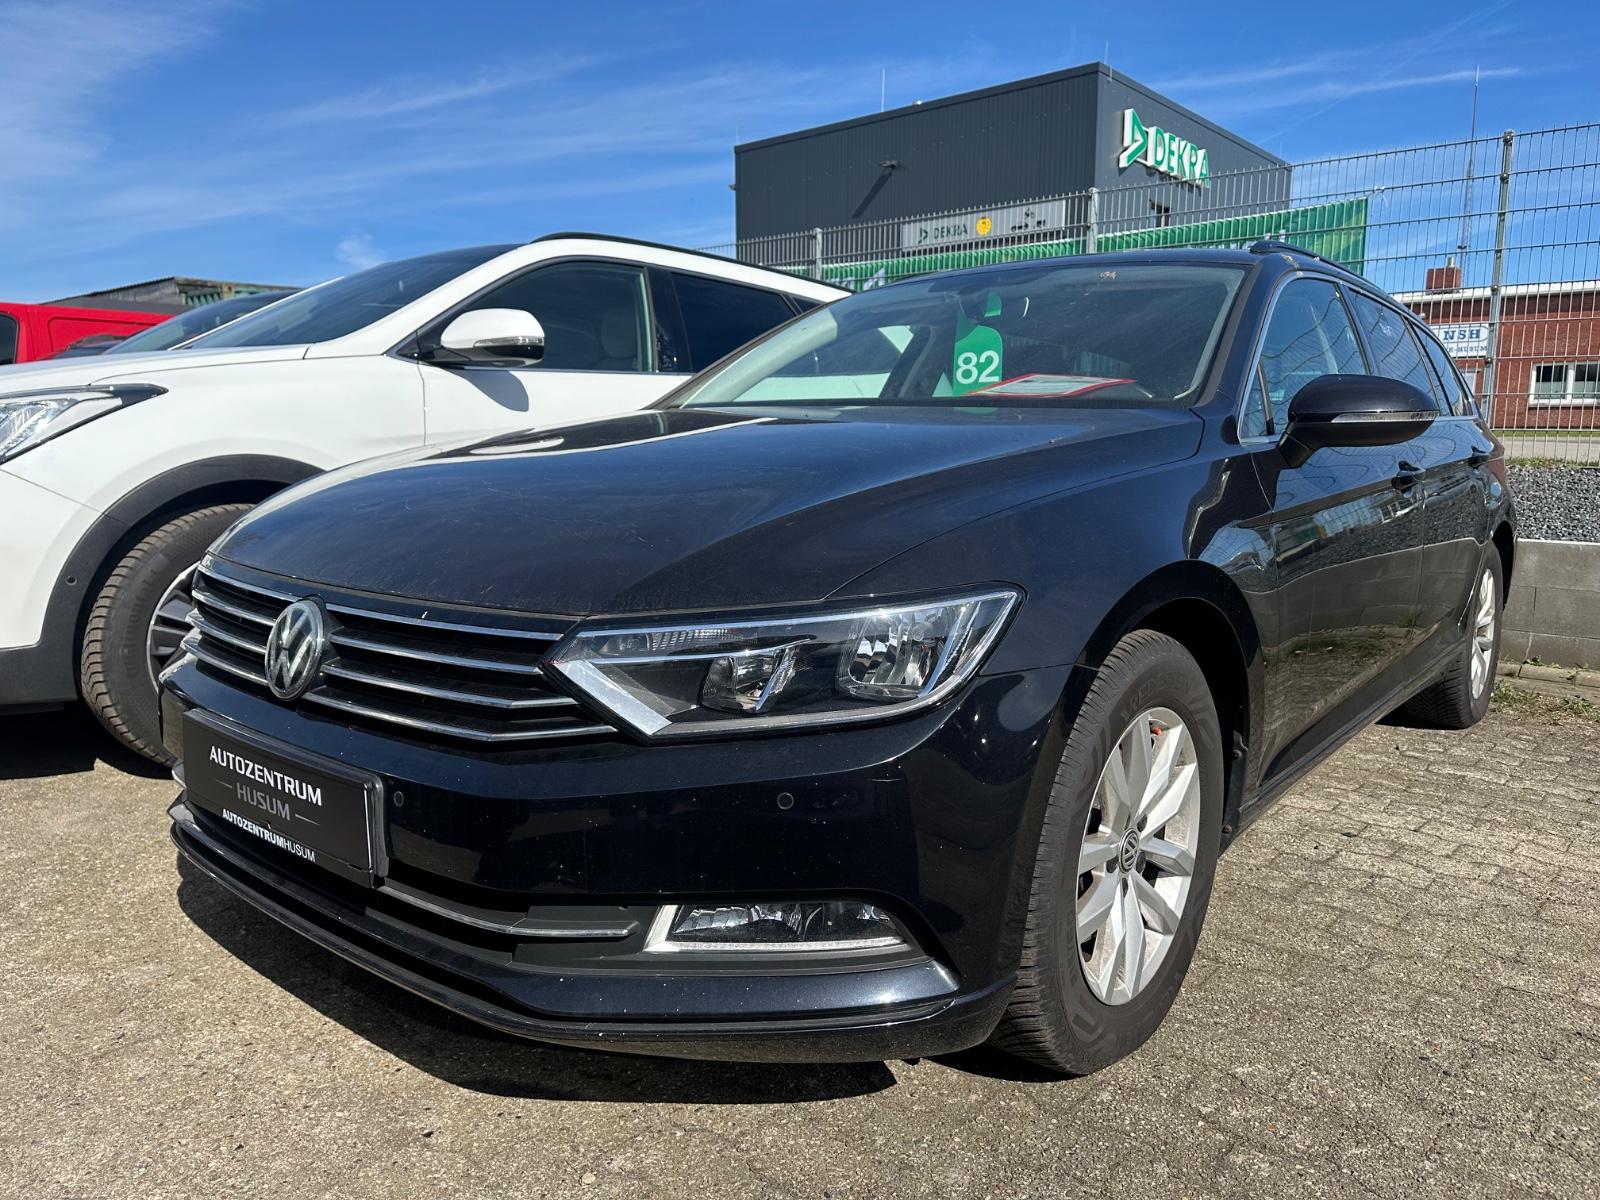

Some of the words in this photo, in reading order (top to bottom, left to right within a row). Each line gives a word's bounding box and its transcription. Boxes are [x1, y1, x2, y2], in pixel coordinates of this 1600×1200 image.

[1146, 126, 1211, 189] DEKRA
[934, 223, 968, 240] DEKRA
[1443, 329, 1481, 341] NSH
[956, 350, 1000, 384] 82
[209, 745, 322, 806] AUTOZENTRUM
[236, 782, 291, 821] HUSUM
[222, 808, 316, 863] AUTOZENTRUMHUSUM
